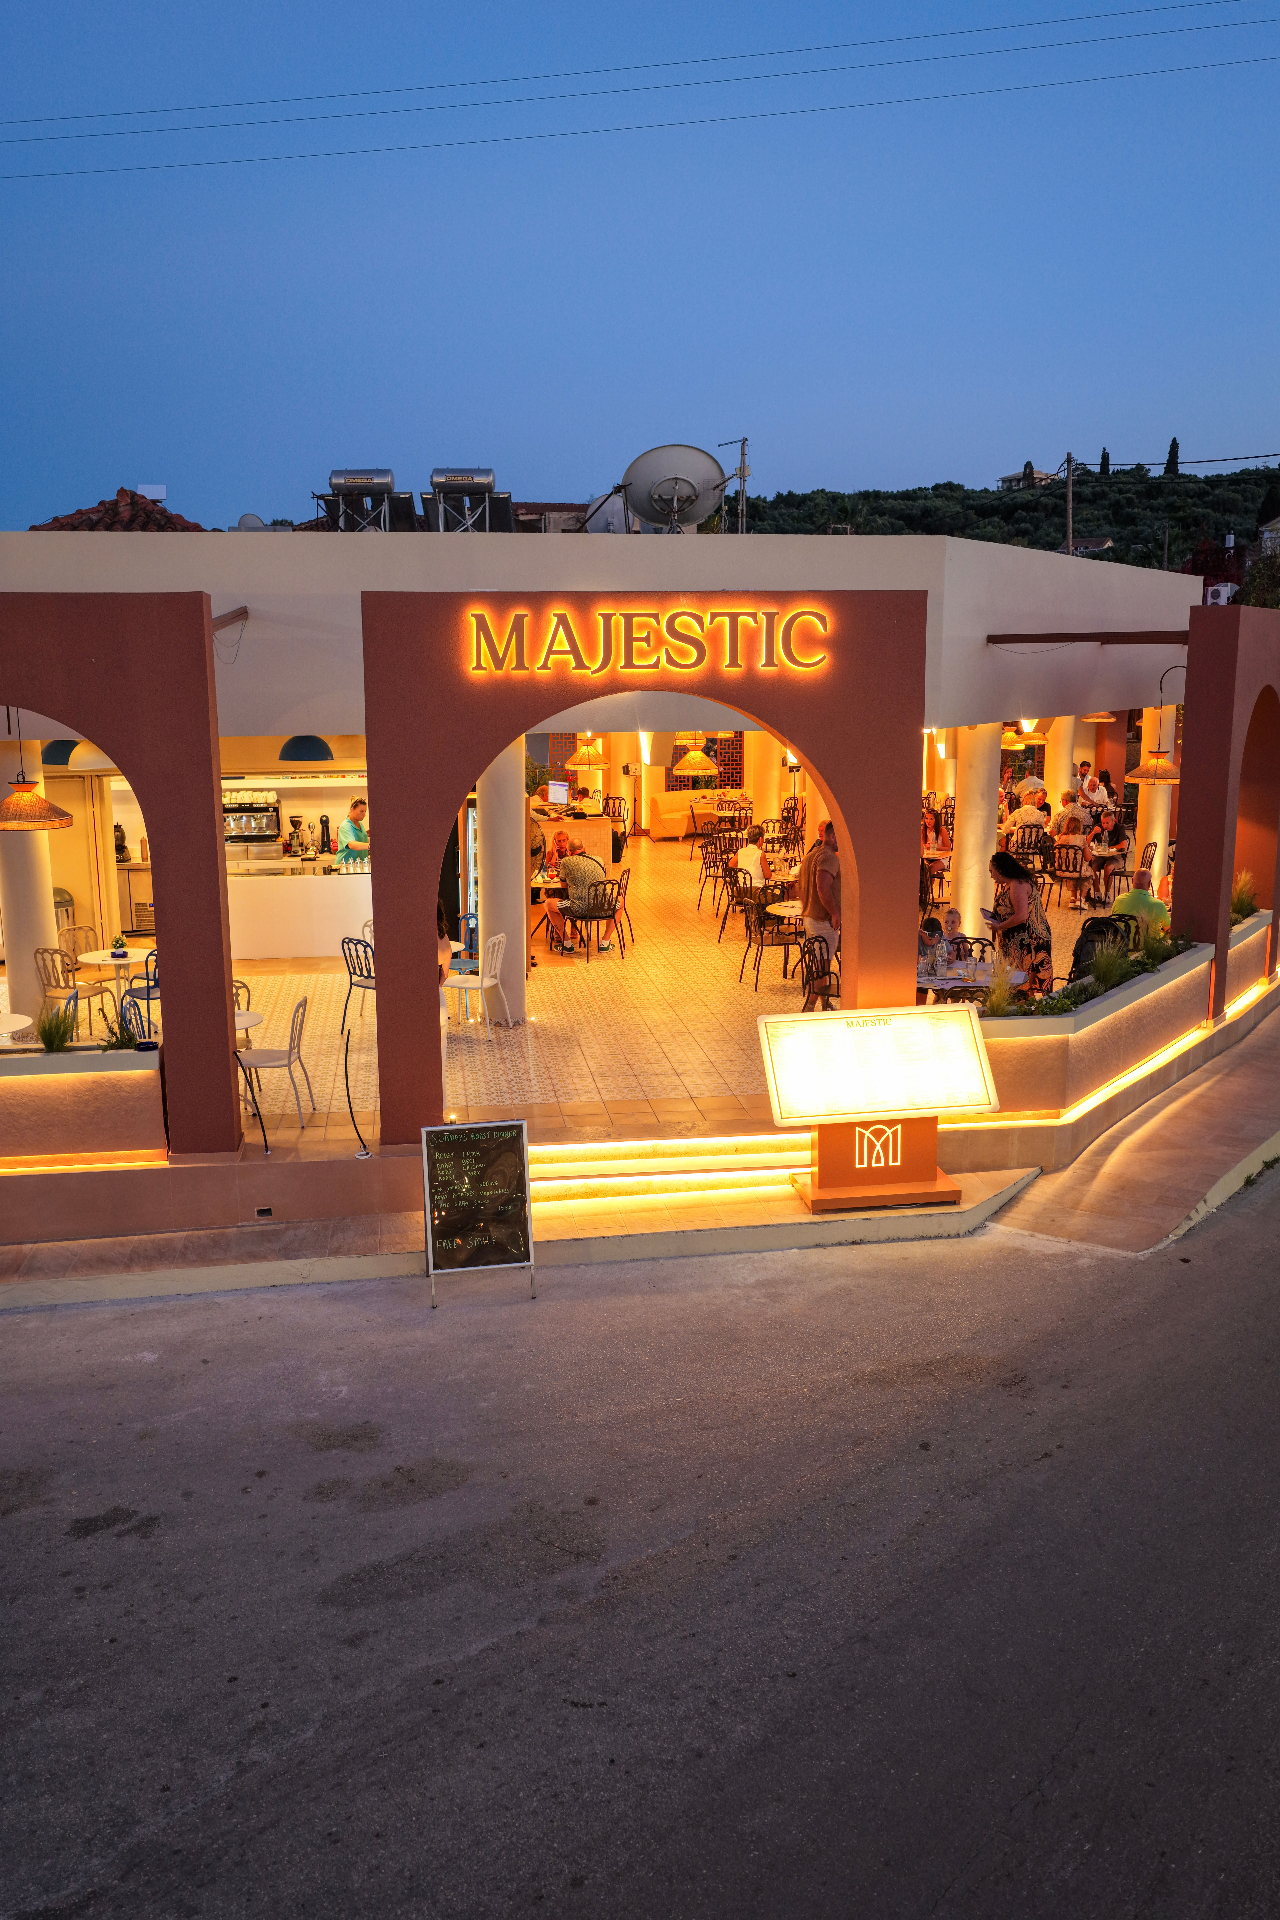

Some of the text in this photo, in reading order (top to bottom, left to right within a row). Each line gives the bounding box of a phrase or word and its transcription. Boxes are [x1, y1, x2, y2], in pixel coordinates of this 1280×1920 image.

[470, 610, 829, 676] MAJESTIC
[845, 1018, 892, 1029] MAJESTIC
[436, 1236, 497, 1251] FREE SMILE
